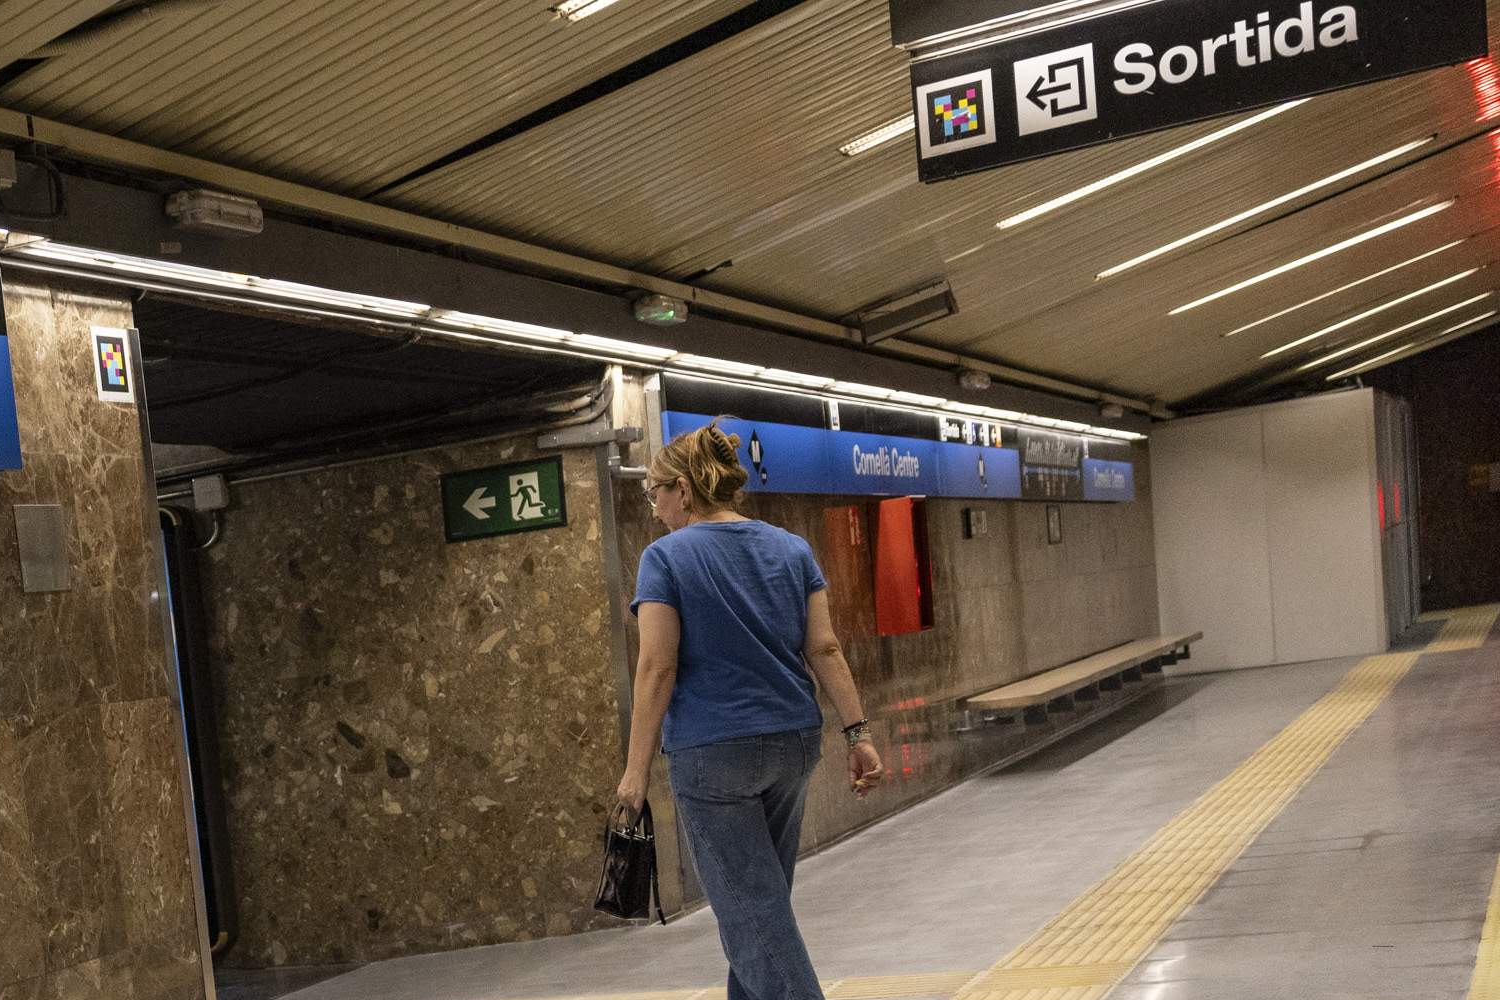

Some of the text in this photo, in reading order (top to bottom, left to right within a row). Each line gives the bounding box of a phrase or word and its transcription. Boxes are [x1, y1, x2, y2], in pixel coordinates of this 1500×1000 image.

[1112, 1, 1359, 95] Sortida
[853, 444, 920, 478] Cornellà Centre
